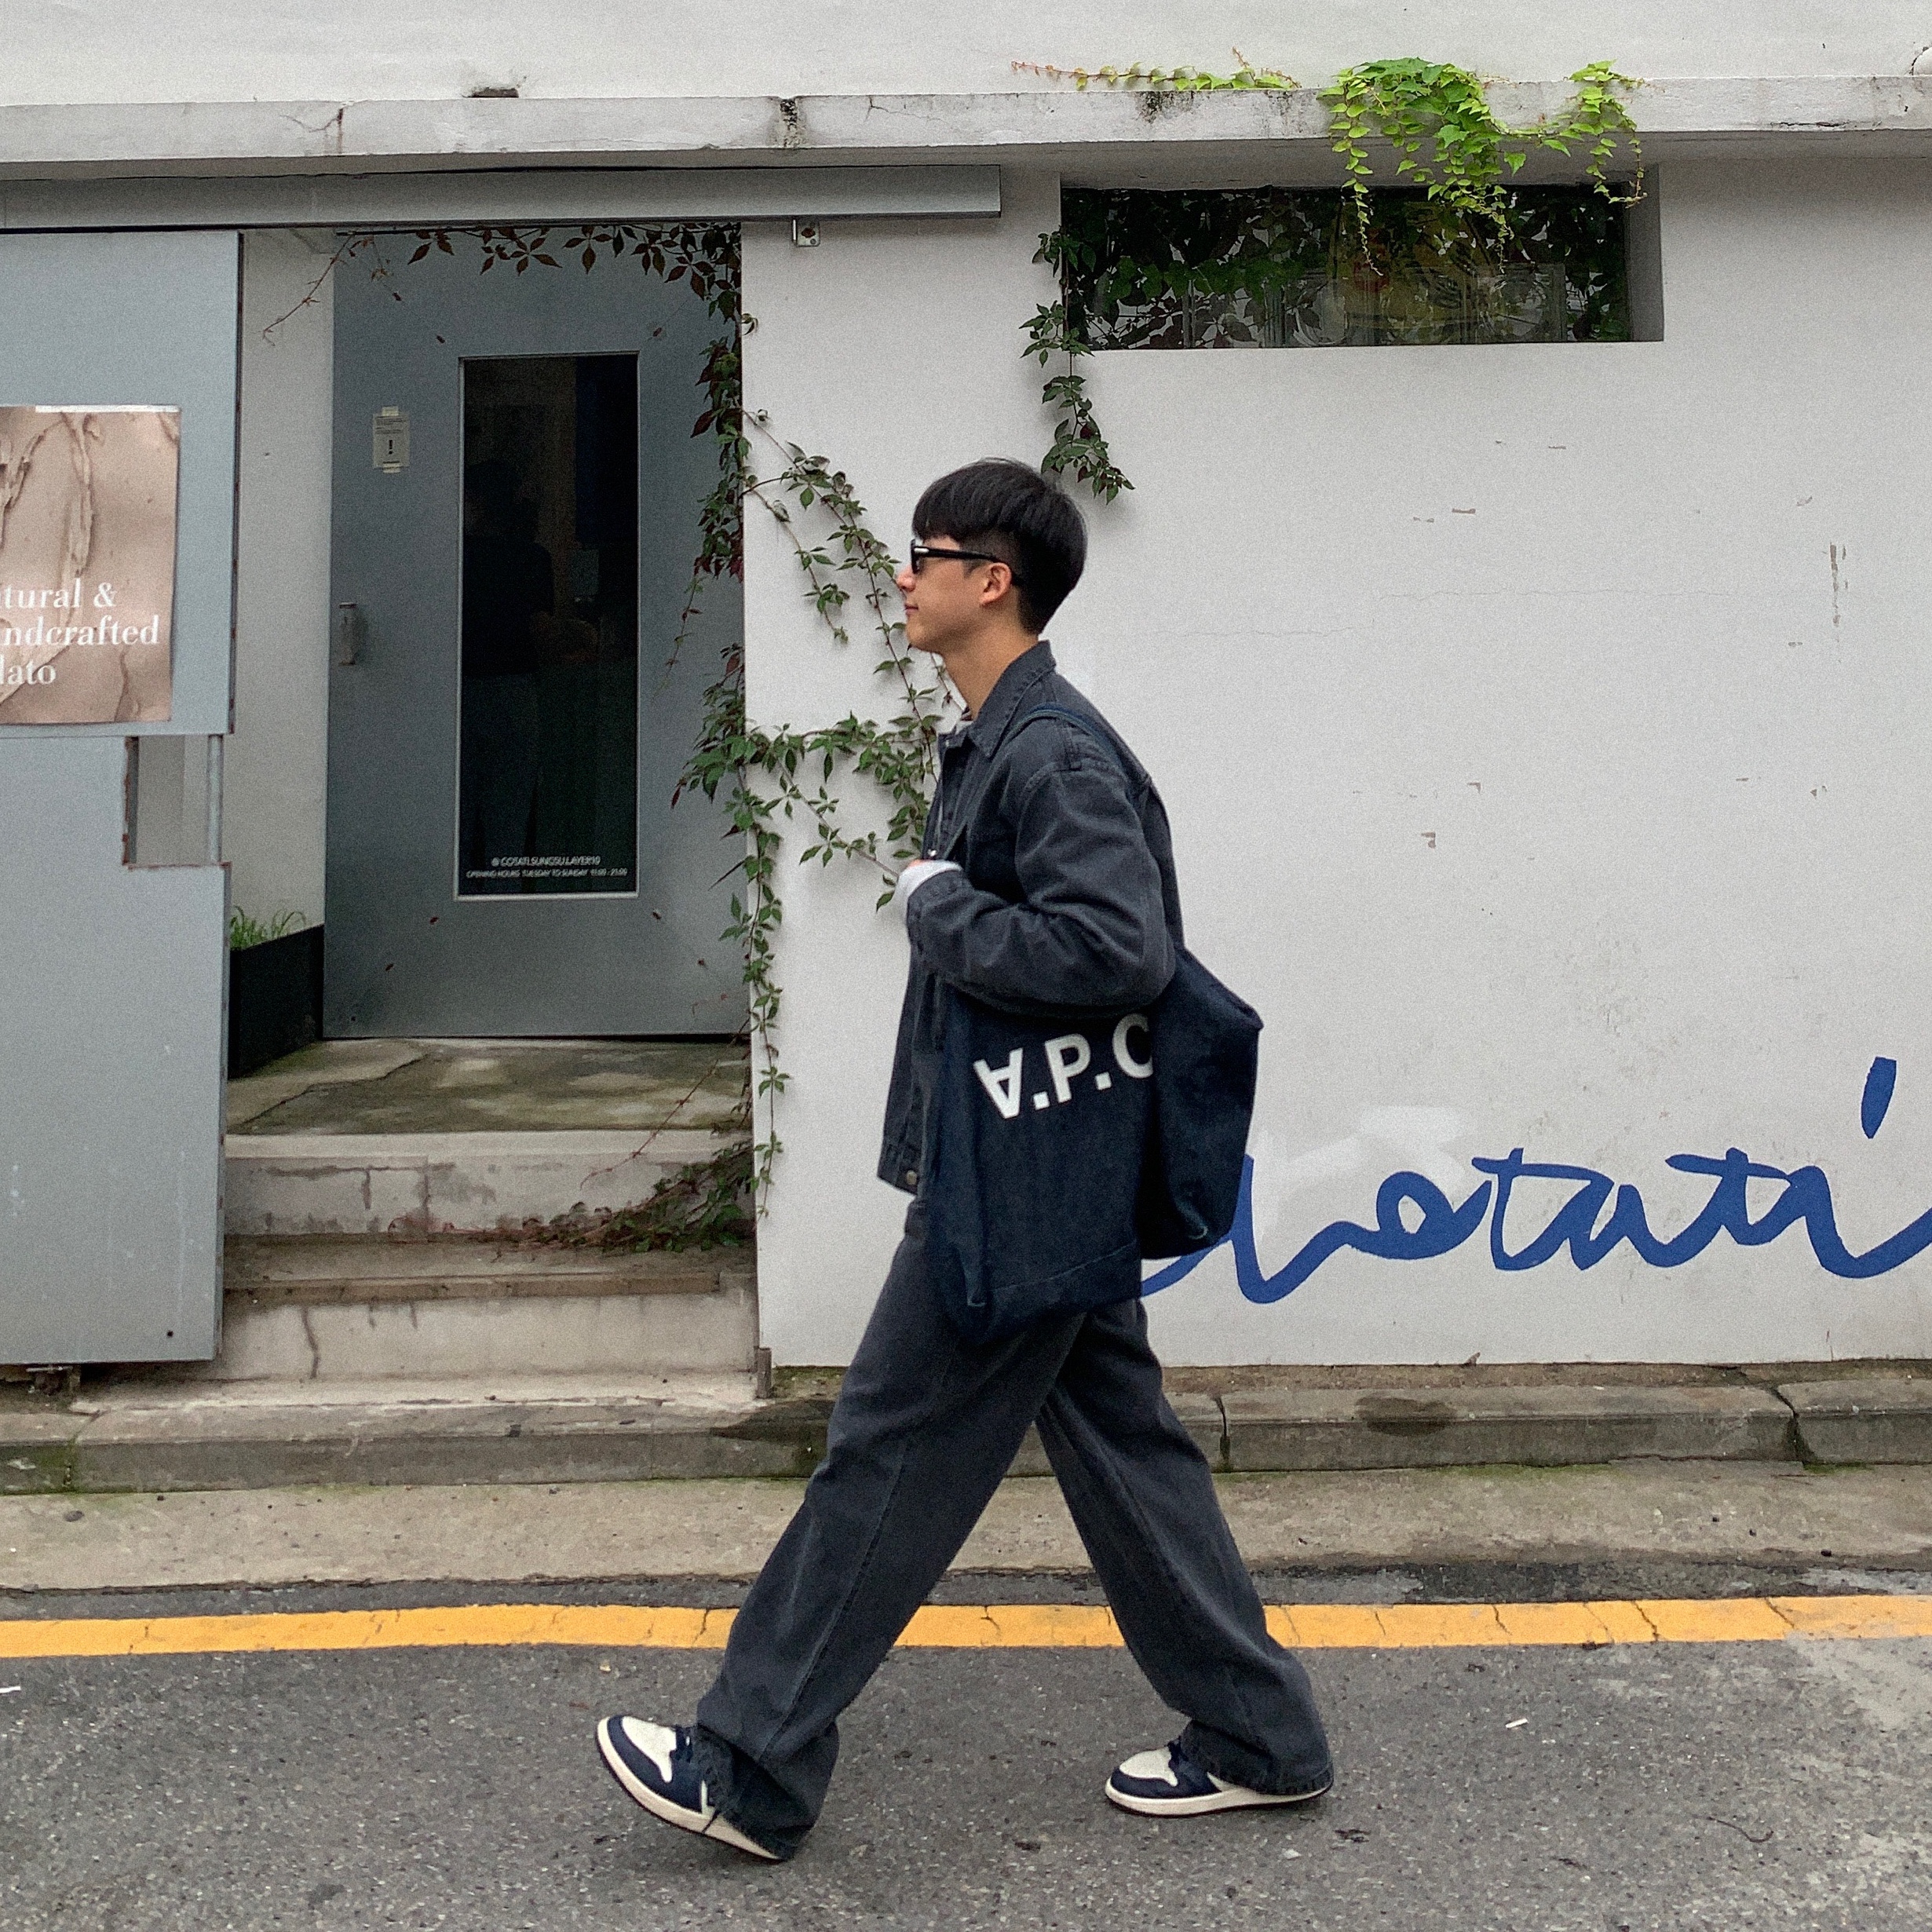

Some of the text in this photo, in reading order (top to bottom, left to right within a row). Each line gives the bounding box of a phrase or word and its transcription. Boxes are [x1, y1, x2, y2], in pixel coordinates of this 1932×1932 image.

[0, 578, 118, 608] tural &
[3, 615, 159, 645] ndcrafted
[0, 654, 57, 685] lato
